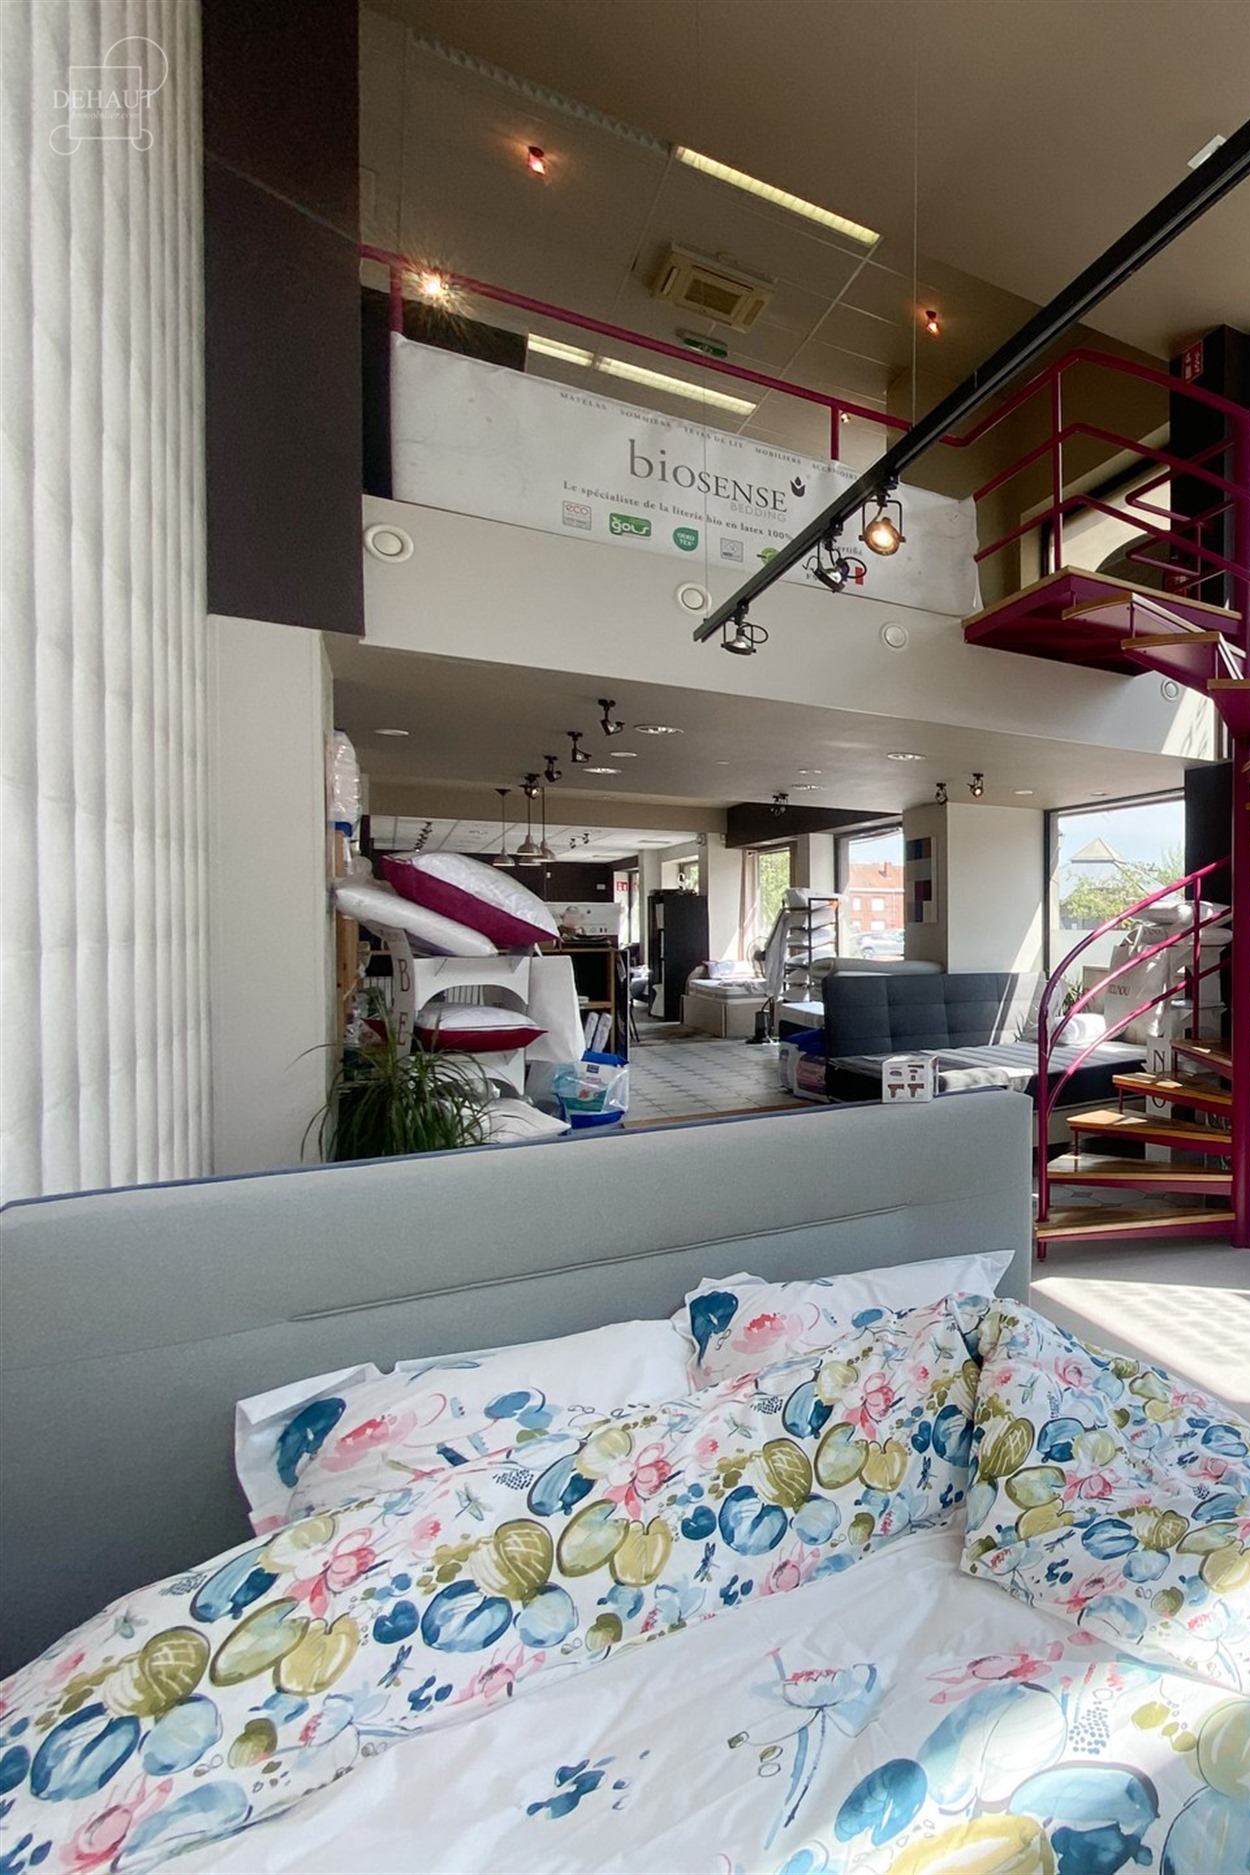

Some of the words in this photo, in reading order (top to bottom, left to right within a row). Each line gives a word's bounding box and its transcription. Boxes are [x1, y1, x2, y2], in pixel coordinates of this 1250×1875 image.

[560, 391, 608, 411] MATELAS
[755, 446, 802, 465] MOBILIERS
[563, 480, 577, 492] Le
[581, 487, 640, 507] spécialiste
[643, 499, 657, 510] de
[659, 502, 669, 513] la
[672, 505, 703, 521] literie
[706, 514, 723, 526] bio
[726, 520, 738, 530] en
[740, 521, 764, 535] latex
[730, 501, 787, 523] BEDDING
